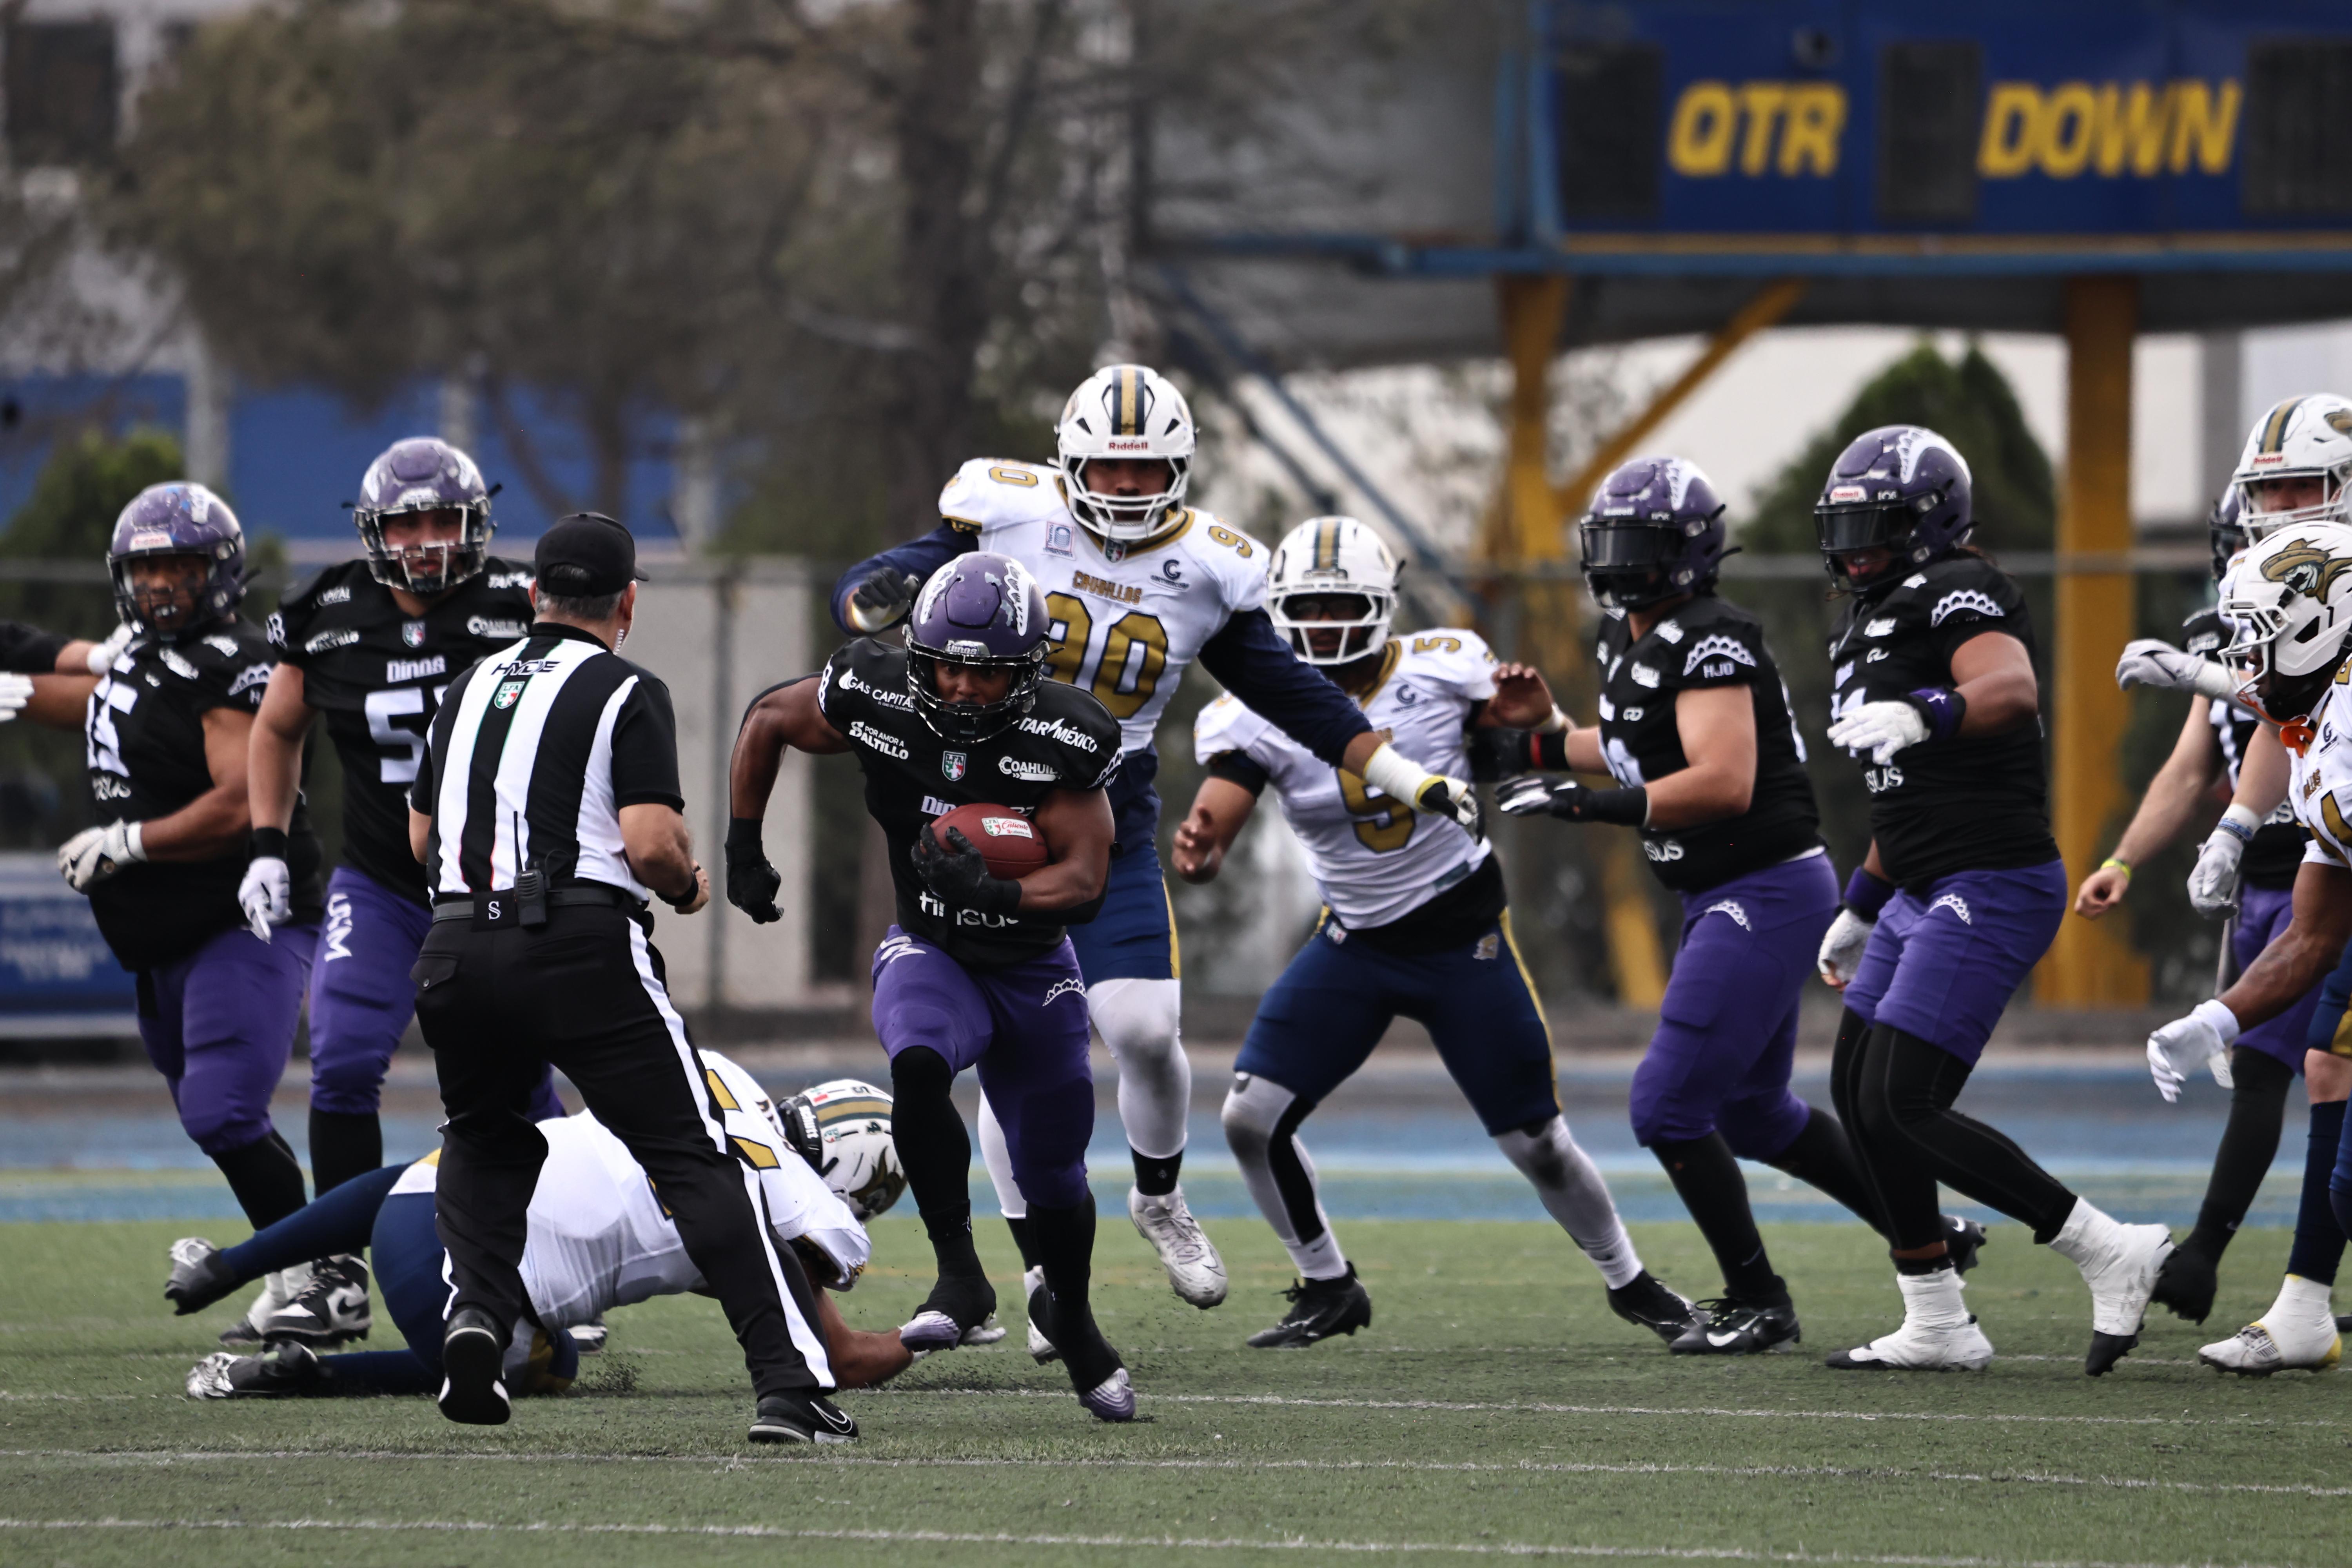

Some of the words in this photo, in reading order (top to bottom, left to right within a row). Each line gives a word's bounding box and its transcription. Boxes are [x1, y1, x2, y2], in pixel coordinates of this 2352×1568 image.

[1669, 80, 1847, 176] QTR
[1978, 80, 2242, 176] DOWN
[490, 659, 562, 675] HYDE
[1041, 590, 1168, 720] 90
[387, 655, 446, 683] Dinos
[848, 676, 871, 694] GAS
[849, 721, 909, 760] SALTILLO
[865, 726, 878, 737] POR
[878, 732, 898, 745] AMOR
[1052, 726, 1097, 753] MÉXICO
[1336, 767, 1416, 853] 5
[1002, 820, 1029, 830] Caliente
[488, 900, 501, 920] S
[866, 1120, 882, 1134] 4
